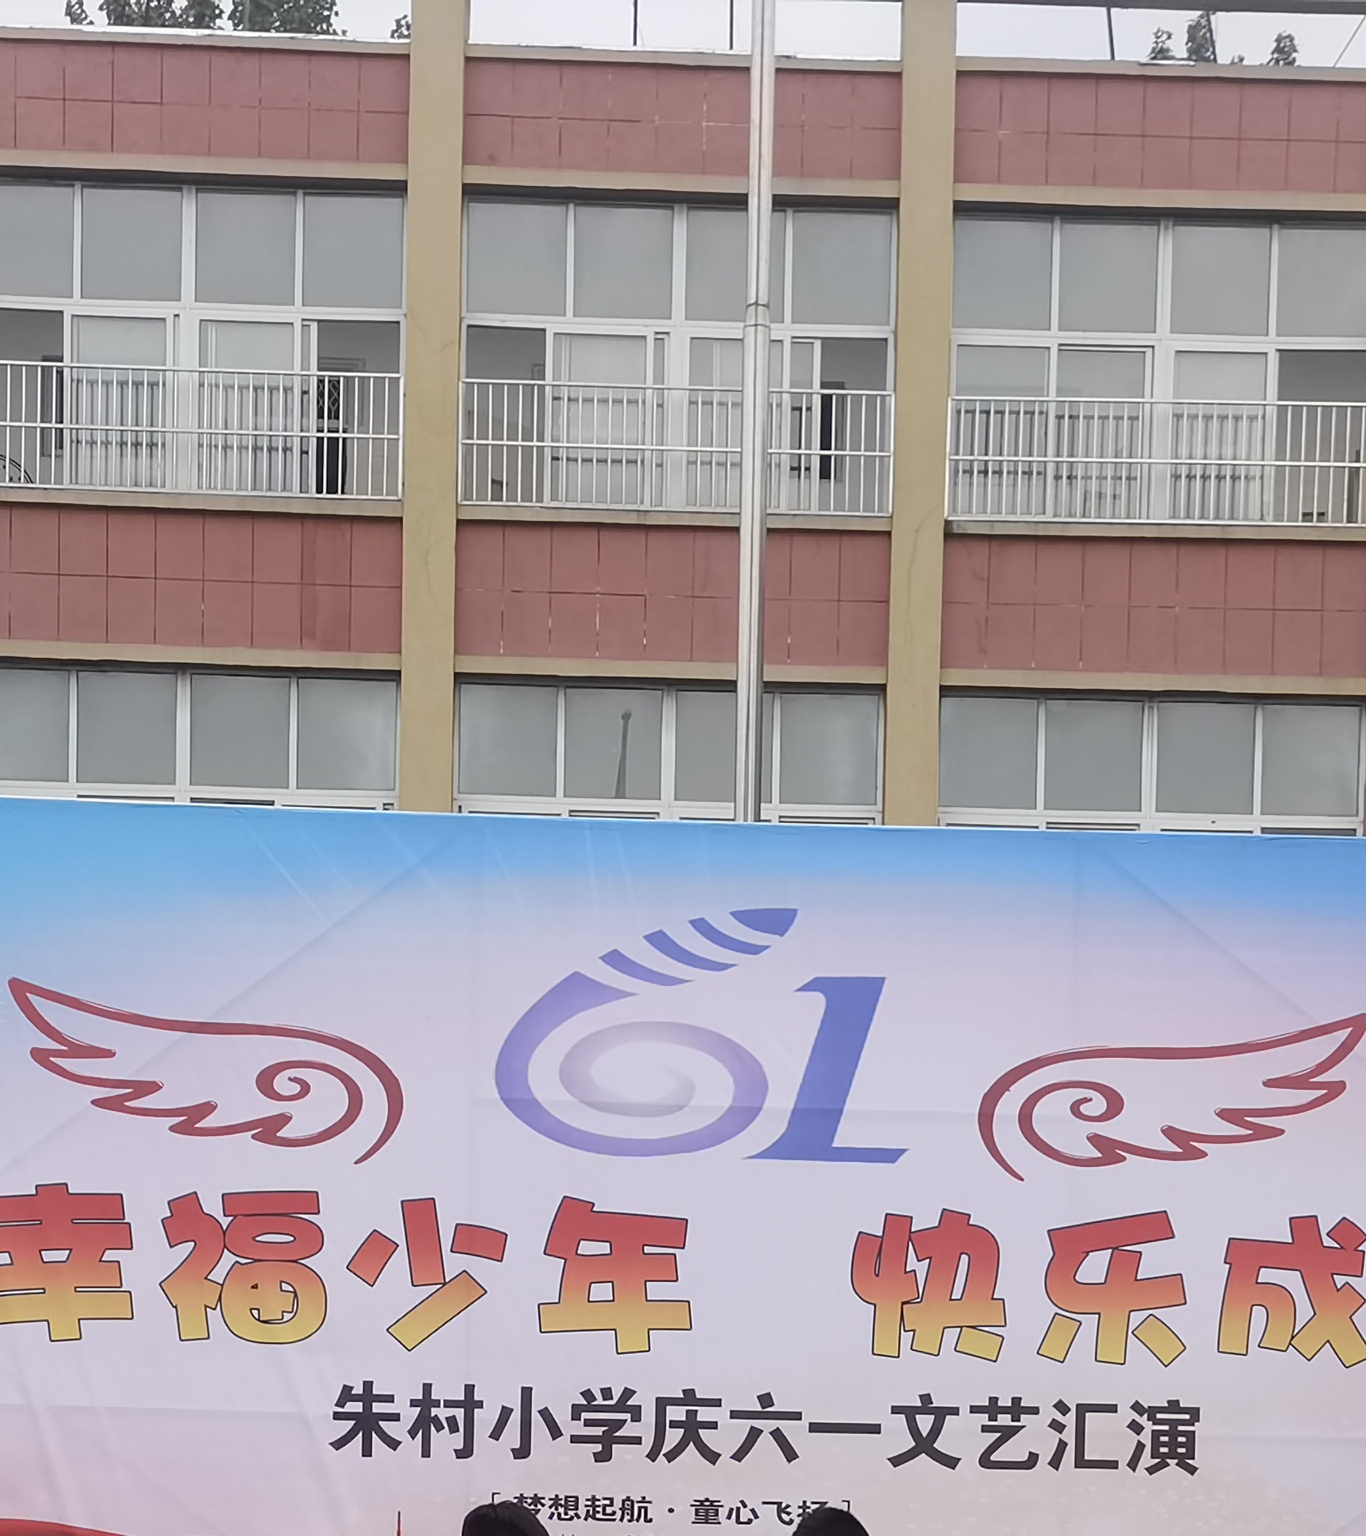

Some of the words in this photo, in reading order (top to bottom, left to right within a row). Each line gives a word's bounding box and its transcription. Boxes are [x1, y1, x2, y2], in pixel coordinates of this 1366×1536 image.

[329, 1379, 1202, 1476] 朱村小学庆六一文艺汇演
